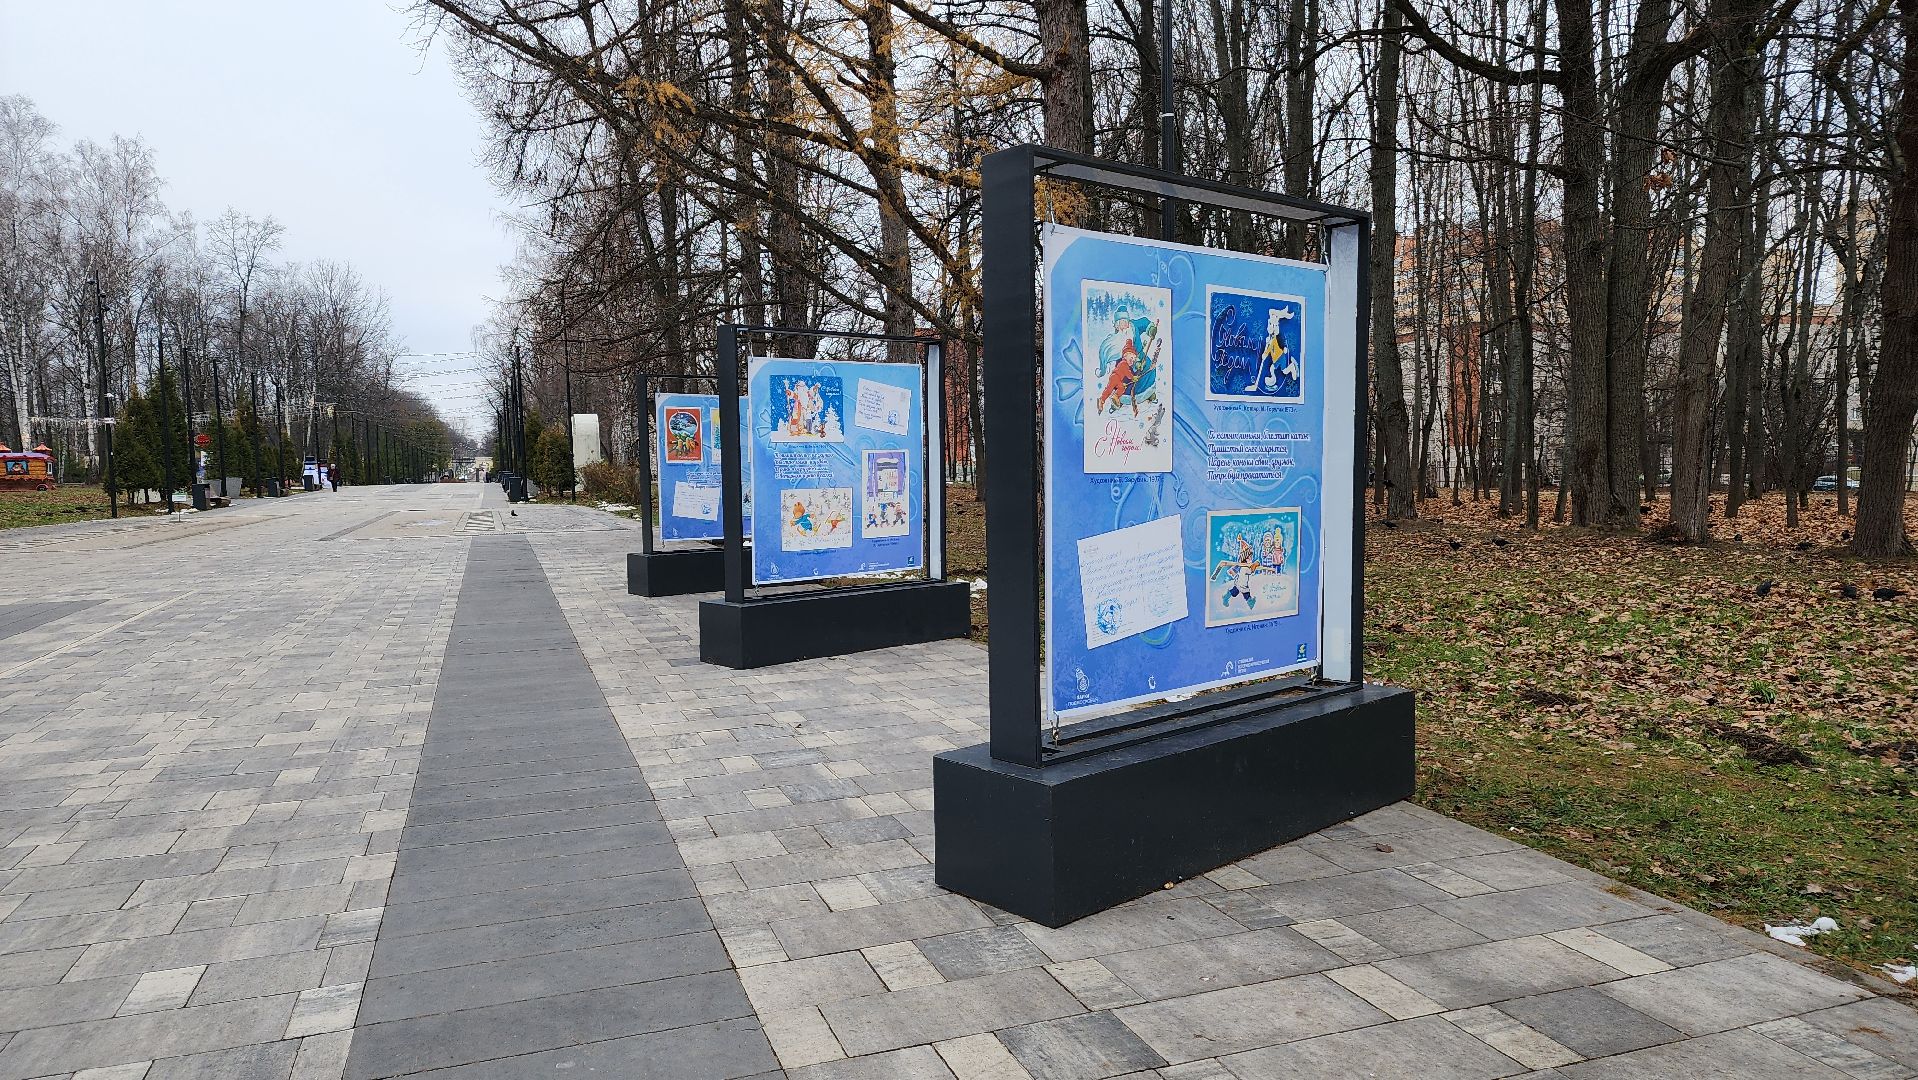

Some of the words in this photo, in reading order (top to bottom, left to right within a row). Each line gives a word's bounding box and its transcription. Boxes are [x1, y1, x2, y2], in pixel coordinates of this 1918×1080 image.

[1208, 443, 1244, 456] Пушистый
[1208, 457, 1231, 470] Надень
[1207, 470, 1240, 483] Попробуй
